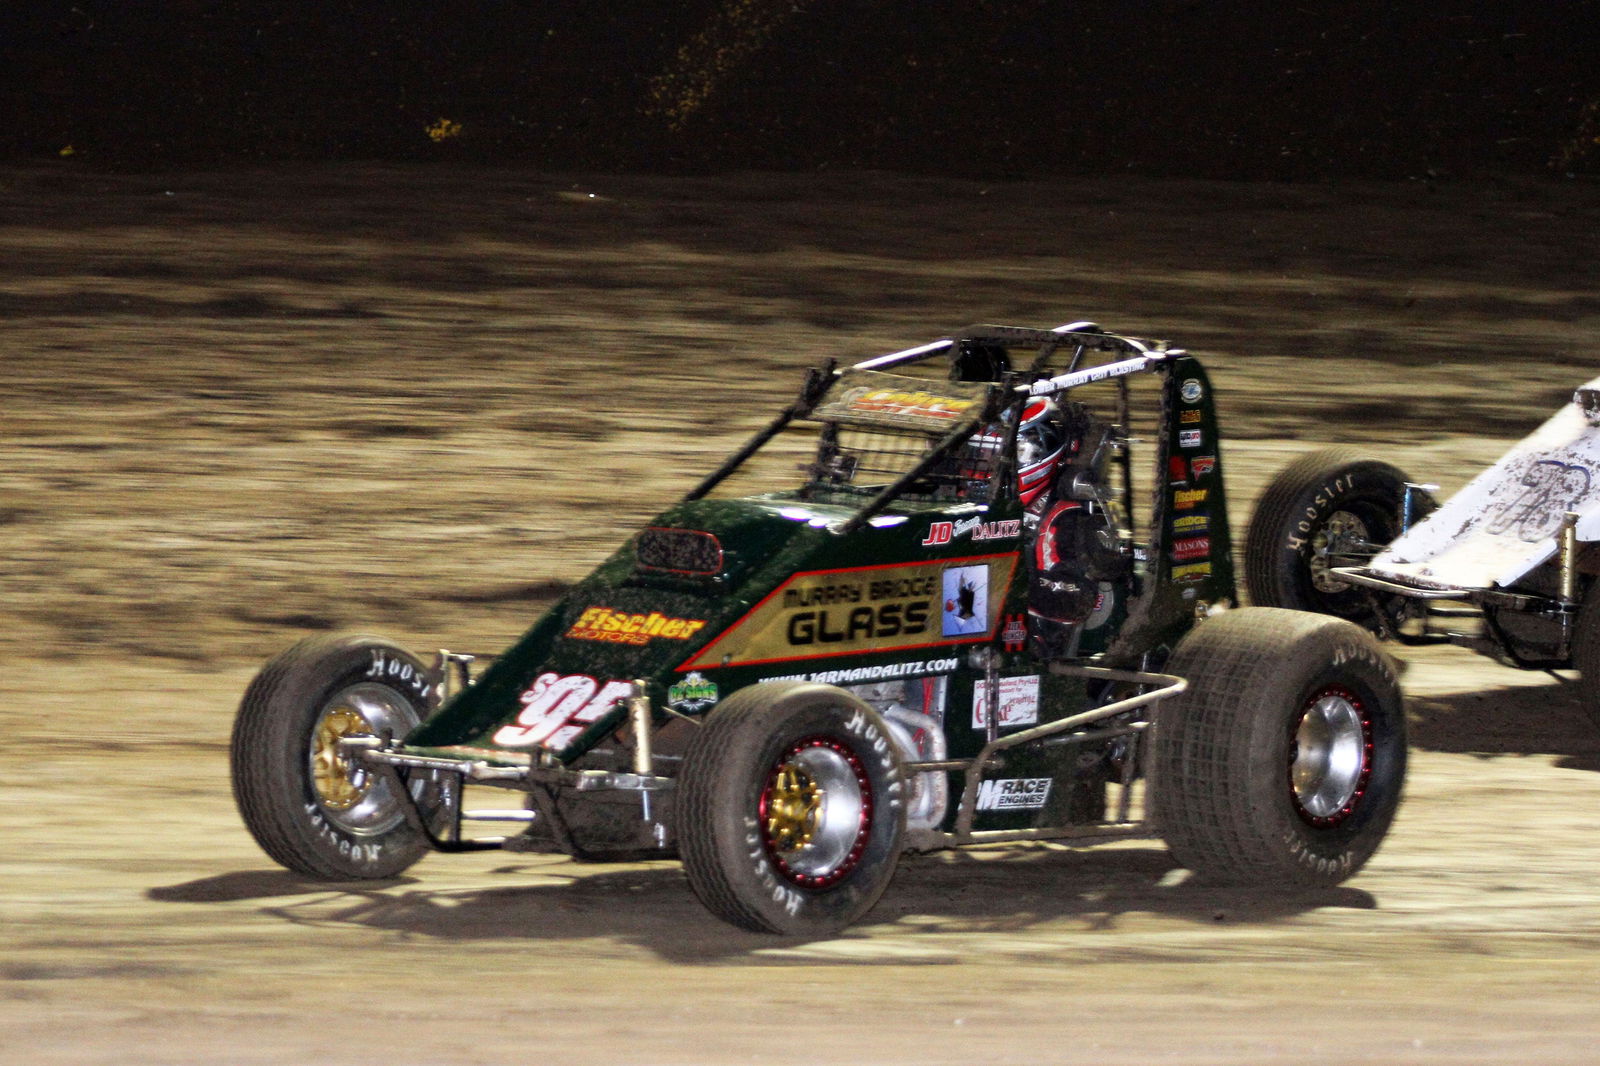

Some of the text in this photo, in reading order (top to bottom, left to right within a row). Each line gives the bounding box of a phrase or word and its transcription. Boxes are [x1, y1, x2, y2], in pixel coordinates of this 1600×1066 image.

[921, 521, 952, 546] JD
[972, 519, 1021, 541] DALITZ
[1175, 540, 1209, 553] MASONS
[869, 576, 936, 600] BRIDGE
[574, 606, 707, 639] Fischer
[788, 601, 930, 645] GLASS
[566, 628, 650, 645] MOTORS
[759, 657, 959, 685] WJARMANDALITZ.COM
[999, 794, 1044, 804] ENGINES
[1003, 780, 1048, 794] RACE
